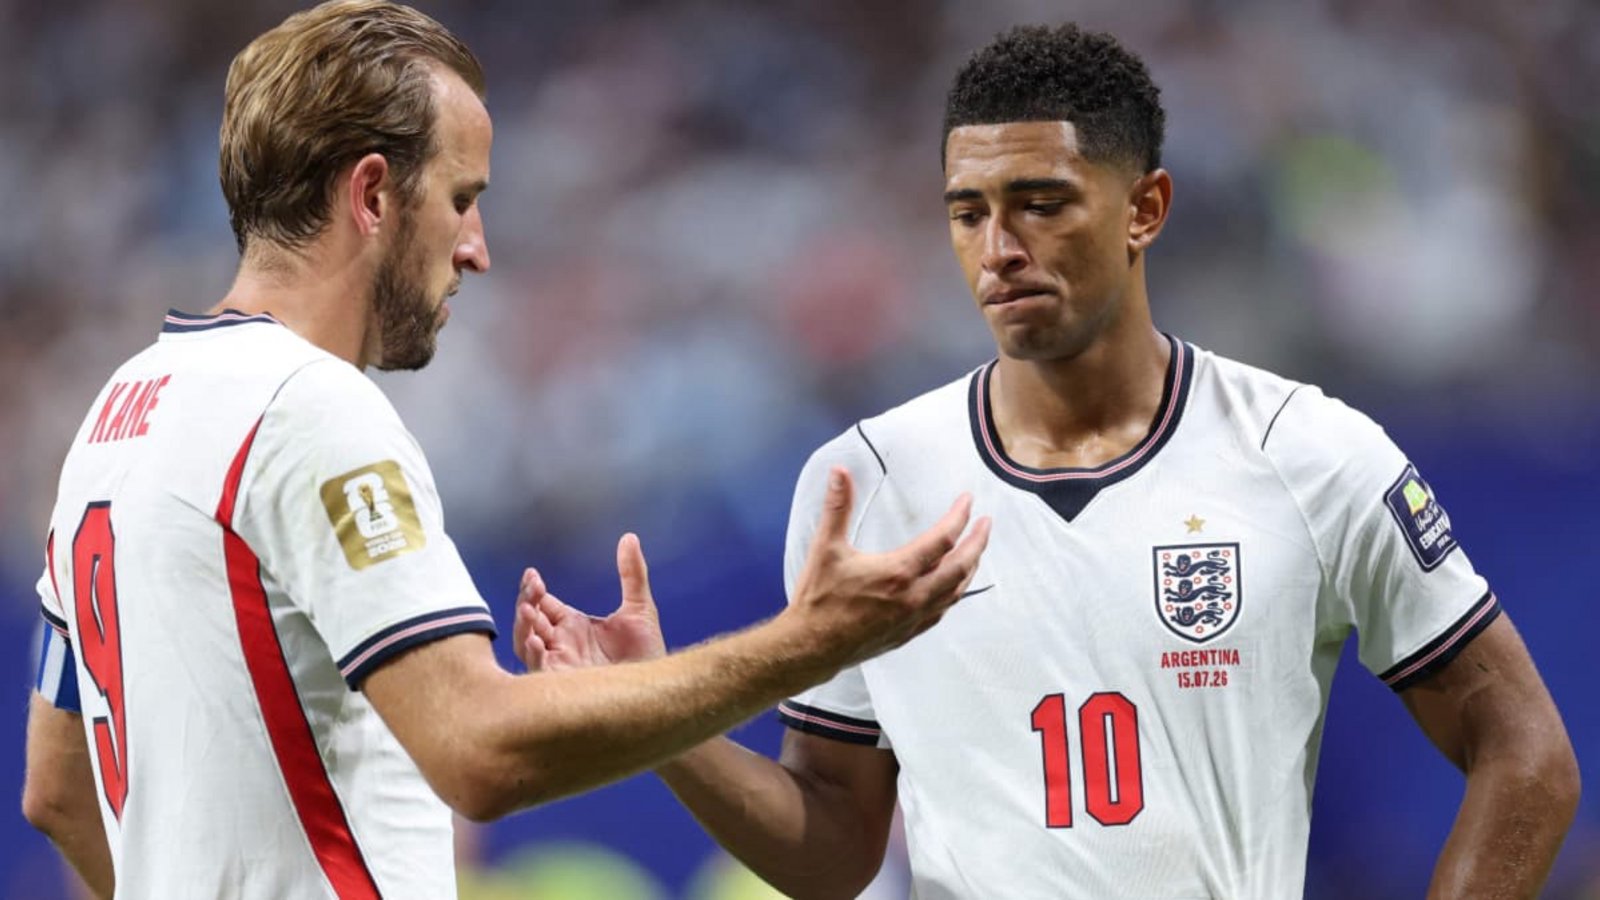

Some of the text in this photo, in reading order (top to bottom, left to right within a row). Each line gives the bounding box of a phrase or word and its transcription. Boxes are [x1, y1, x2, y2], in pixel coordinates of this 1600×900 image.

[88, 374, 171, 443] KANE
[72, 501, 128, 825] 9
[1161, 649, 1240, 668] ARGENTINA
[1178, 671, 1228, 688] 15.07.26
[1031, 691, 1144, 828] 10
